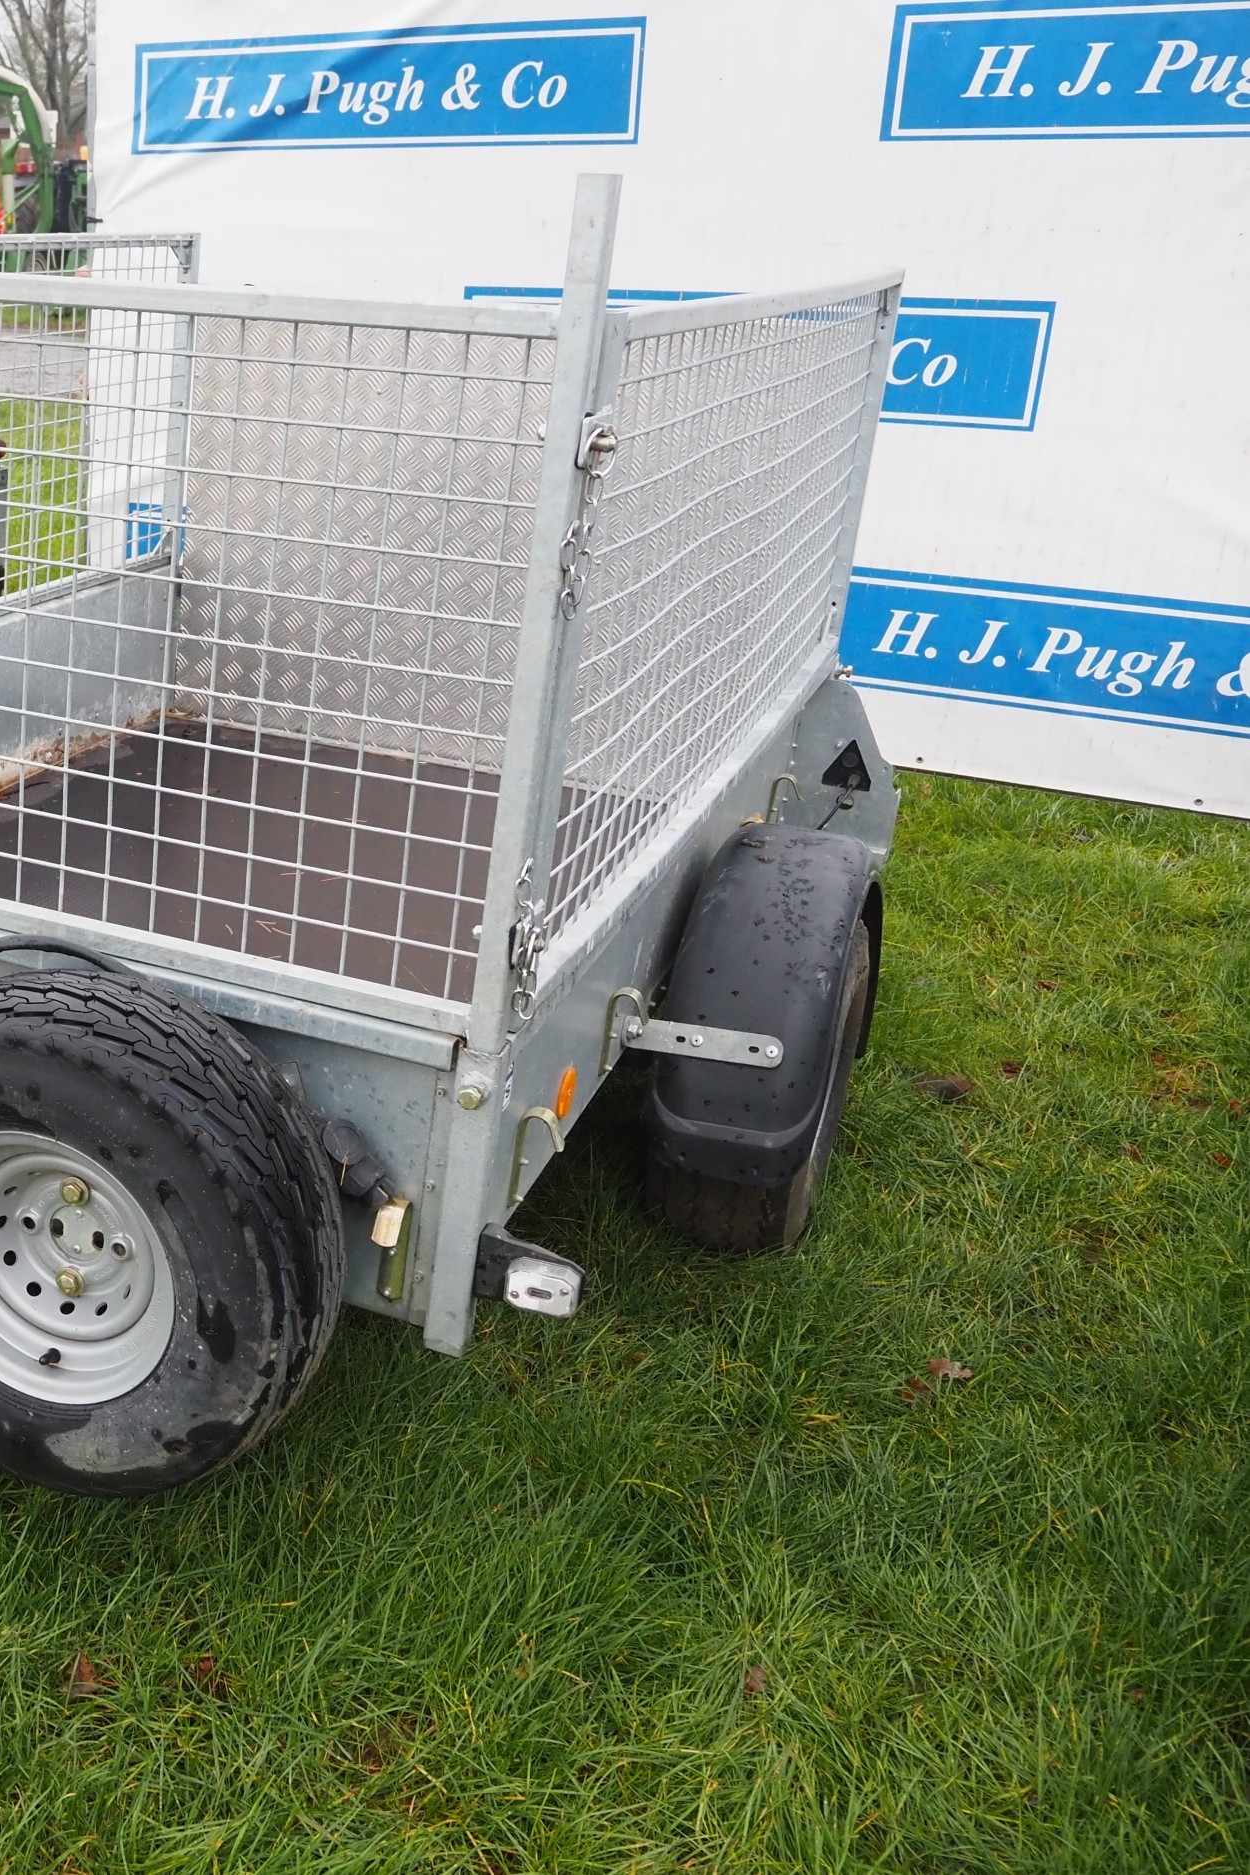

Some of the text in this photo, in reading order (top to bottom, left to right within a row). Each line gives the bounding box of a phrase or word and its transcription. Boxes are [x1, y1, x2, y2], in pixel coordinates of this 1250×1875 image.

[185, 61, 568, 125] H. J. Pugh & Co
[961, 45, 1035, 98] H.
[1058, 42, 1113, 96] J.
[887, 337, 958, 388] Co
[872, 609, 939, 659] H.
[959, 620, 1008, 668] J.
[1028, 627, 1196, 697] Pugh
